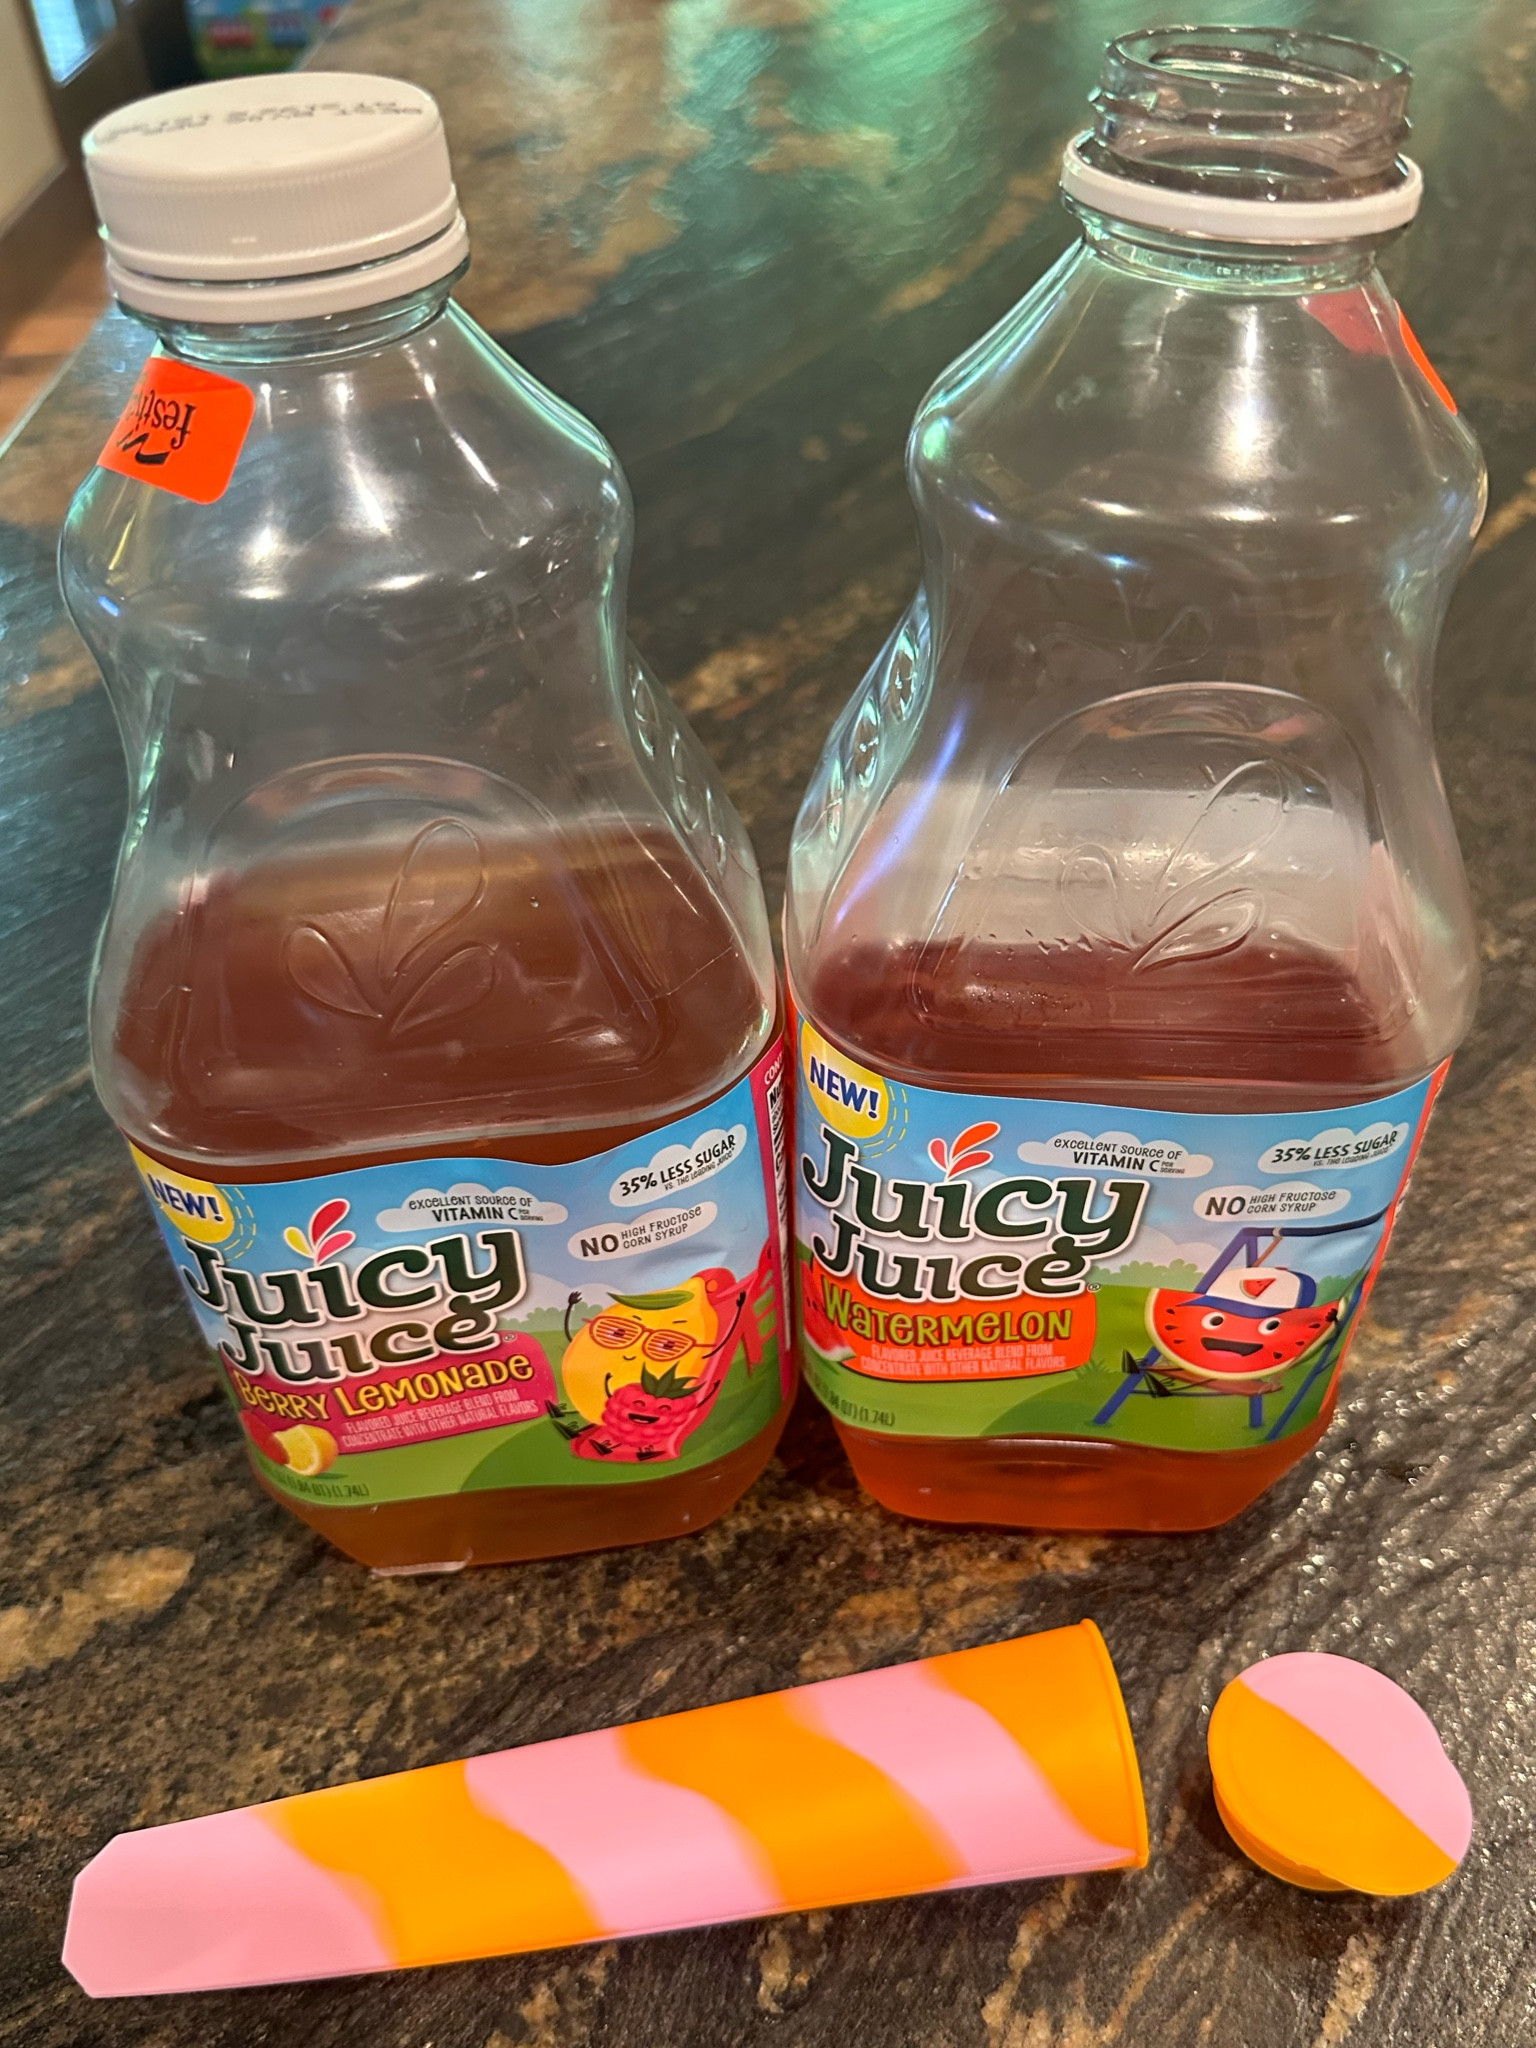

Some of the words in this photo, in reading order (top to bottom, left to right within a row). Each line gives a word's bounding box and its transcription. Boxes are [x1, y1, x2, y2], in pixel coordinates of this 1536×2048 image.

[810, 1056, 879, 1119] NEW!
[1167, 1150, 1183, 1160] OF
[1271, 1146, 1311, 1163] 35%
[1314, 1144, 1350, 1160] LESS
[1353, 1130, 1398, 1155] SUGAR
[620, 1172, 657, 1197] 35%
[660, 1159, 693, 1184] LESS
[695, 1134, 736, 1168] SUGAR
[1073, 1151, 1145, 1171] VITAMIN
[1149, 1160, 1160, 1172] C
[146, 1173, 225, 1223] NEW!
[520, 1197, 533, 1207] OF
[801, 1126, 1149, 1256] Juicy
[1249, 1193, 1276, 1205] HIGH
[432, 1207, 504, 1222] VITAMIN
[508, 1208, 518, 1220] C
[1205, 1196, 1246, 1216] NO
[1246, 1204, 1276, 1214] CORN
[1279, 1202, 1318, 1213] SYRUP
[580, 1233, 619, 1257] NO
[621, 1225, 646, 1240] HIGH
[623, 1234, 651, 1249] CORN
[655, 1223, 688, 1241] SYRUP
[812, 1214, 1084, 1299] Juice
[182, 1229, 525, 1327] Juicy
[218, 1306, 501, 1382] Juice
[920, 1348, 944, 1363] JUICE
[946, 1347, 993, 1362] BEVERAGE
[995, 1344, 1024, 1359] BLEND
[1026, 1343, 1053, 1357] FROM
[923, 1361, 948, 1375] WITH
[950, 1360, 979, 1374] OTHER
[981, 1358, 1023, 1373] NATURAL
[1025, 1355, 1066, 1370] FLAVORS
[341, 1426, 405, 1447] CONCENTRATE
[405, 1422, 428, 1438] WITH
[429, 1416, 455, 1433] OTHER
[456, 1406, 499, 1426] NATURAL
[499, 1399, 539, 1417] FLAVORS
[345, 1416, 391, 1433] FLAVORED
[392, 1411, 418, 1426] JUICE
[418, 1400, 463, 1419] BEVERAGE
[463, 1394, 493, 1411] BLEND
[493, 1388, 520, 1405] FROM
